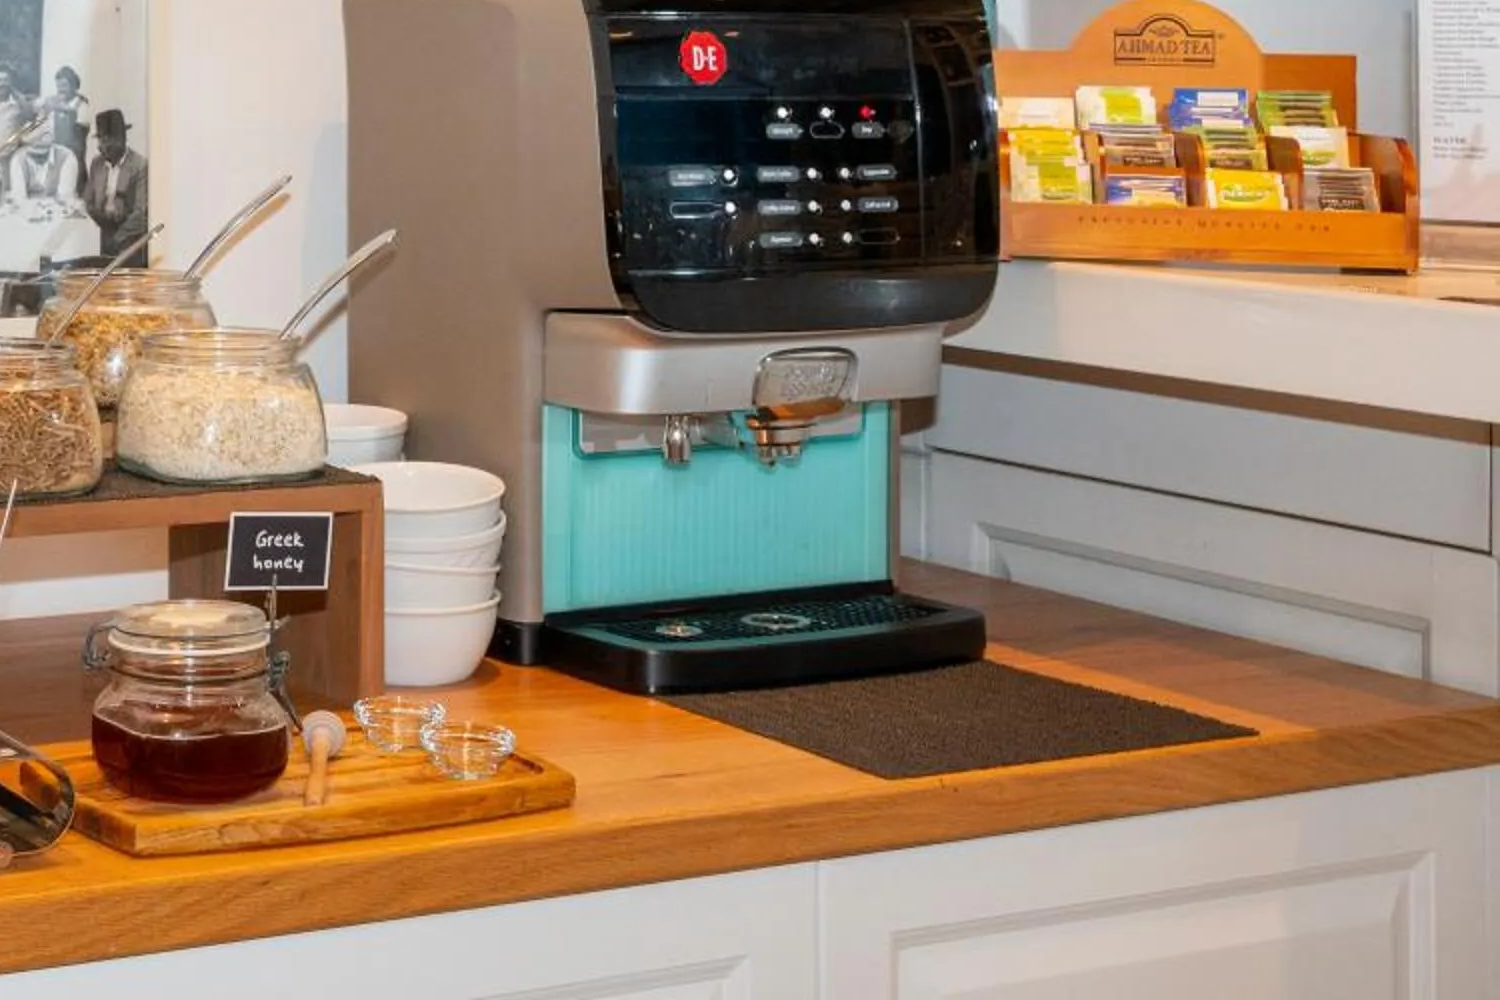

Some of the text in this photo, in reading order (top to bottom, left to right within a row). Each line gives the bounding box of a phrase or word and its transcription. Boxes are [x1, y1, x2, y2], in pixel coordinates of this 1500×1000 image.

[1117, 38, 1212, 55] AHMAD TEA
[255, 529, 305, 548] Greek
[253, 553, 304, 573] honey
